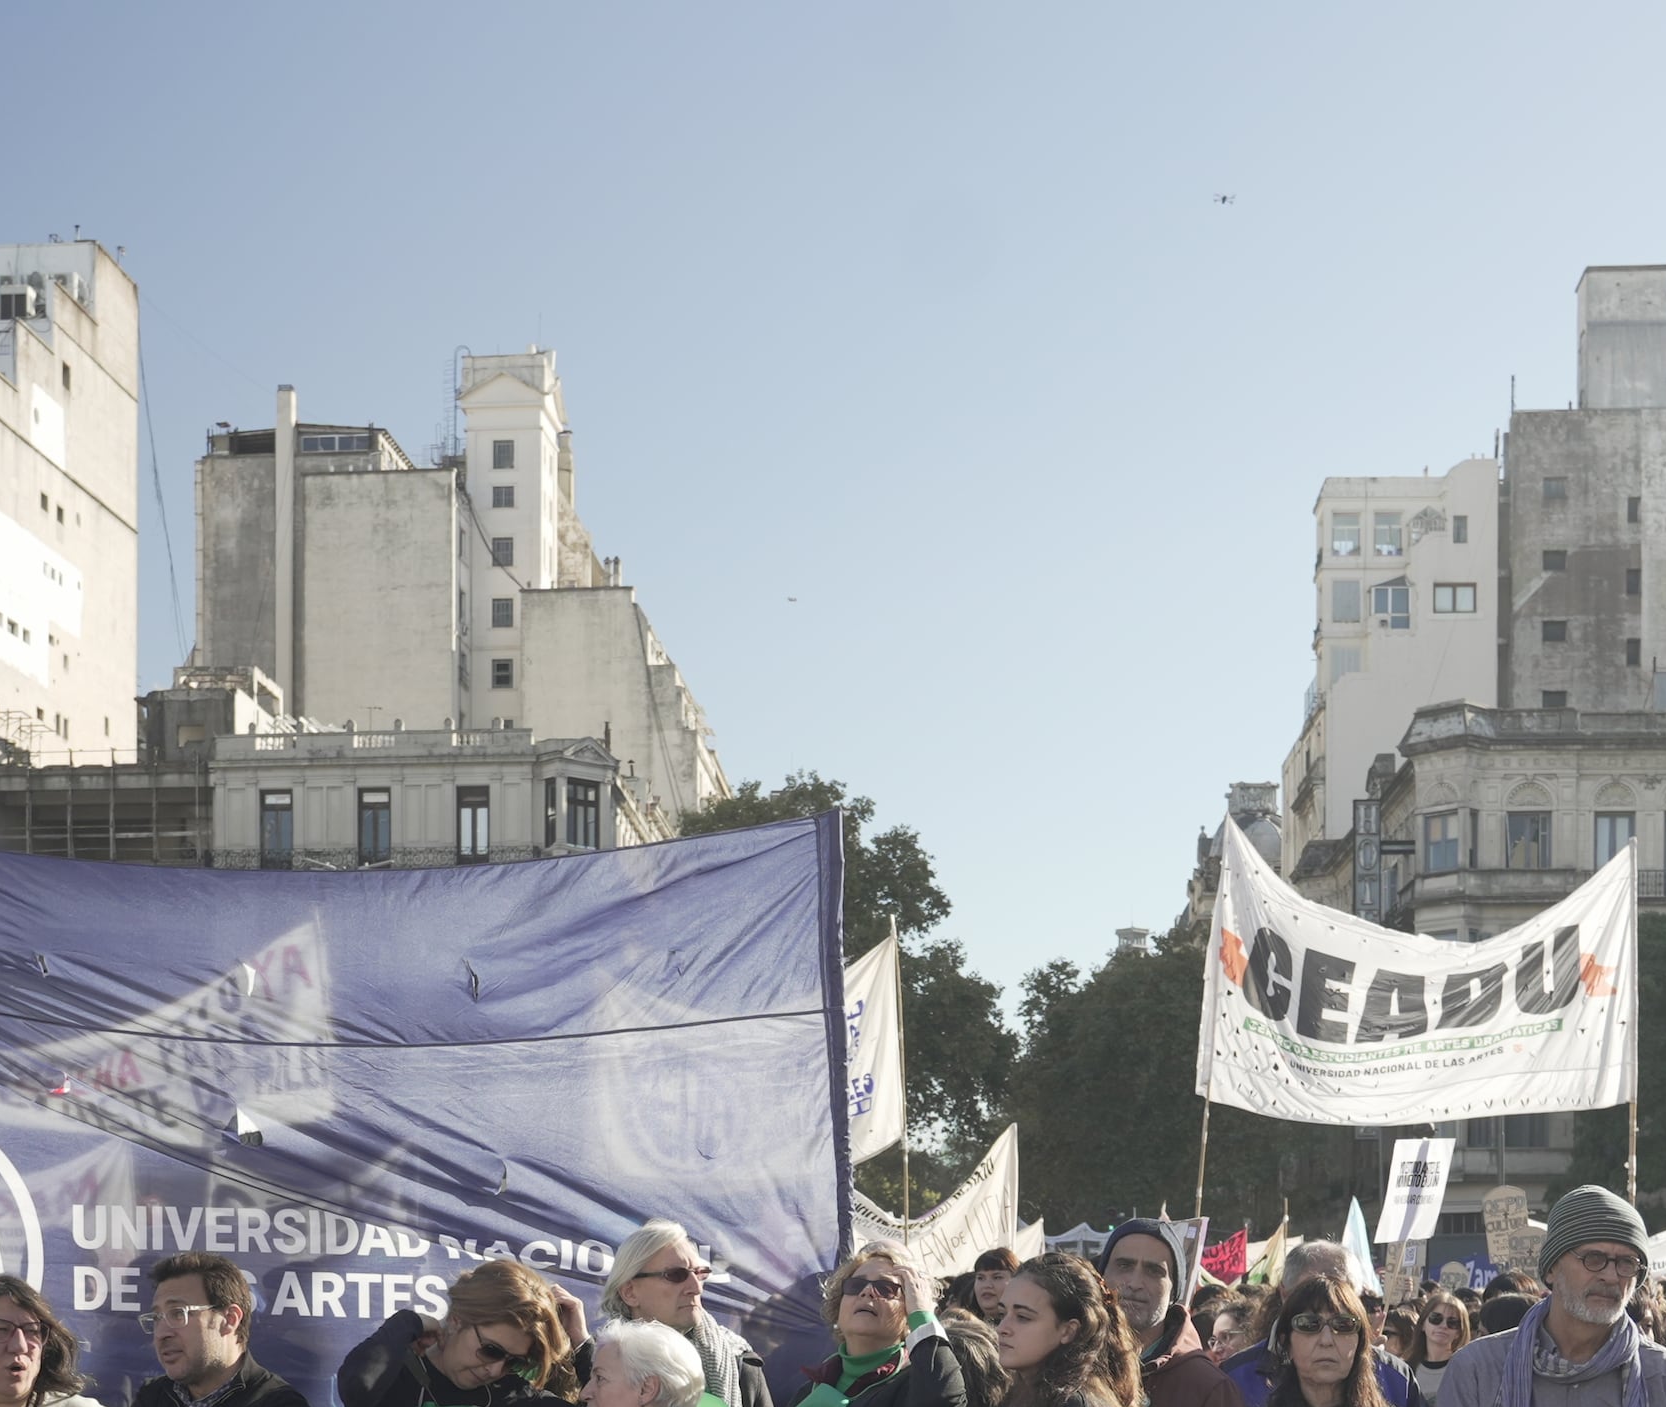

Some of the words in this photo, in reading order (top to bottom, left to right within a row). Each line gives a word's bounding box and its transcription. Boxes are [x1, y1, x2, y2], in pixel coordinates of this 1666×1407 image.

[1244, 924, 1581, 1044] CEADU
[1289, 1060, 1361, 1078] UNIVERSIDAD
[1364, 1062, 1421, 1077] NACIONAL
[1425, 1060, 1440, 1069] DE
[1443, 1057, 1466, 1068] LAS
[1469, 1046, 1504, 1064] ARTES
[1405, 1044, 1422, 1056] DE
[1426, 1038, 1471, 1052] ARTES
[71, 1204, 431, 1259] UNIVERSIDAD
[73, 1265, 141, 1312] DE
[271, 1271, 449, 1321] ARTES
